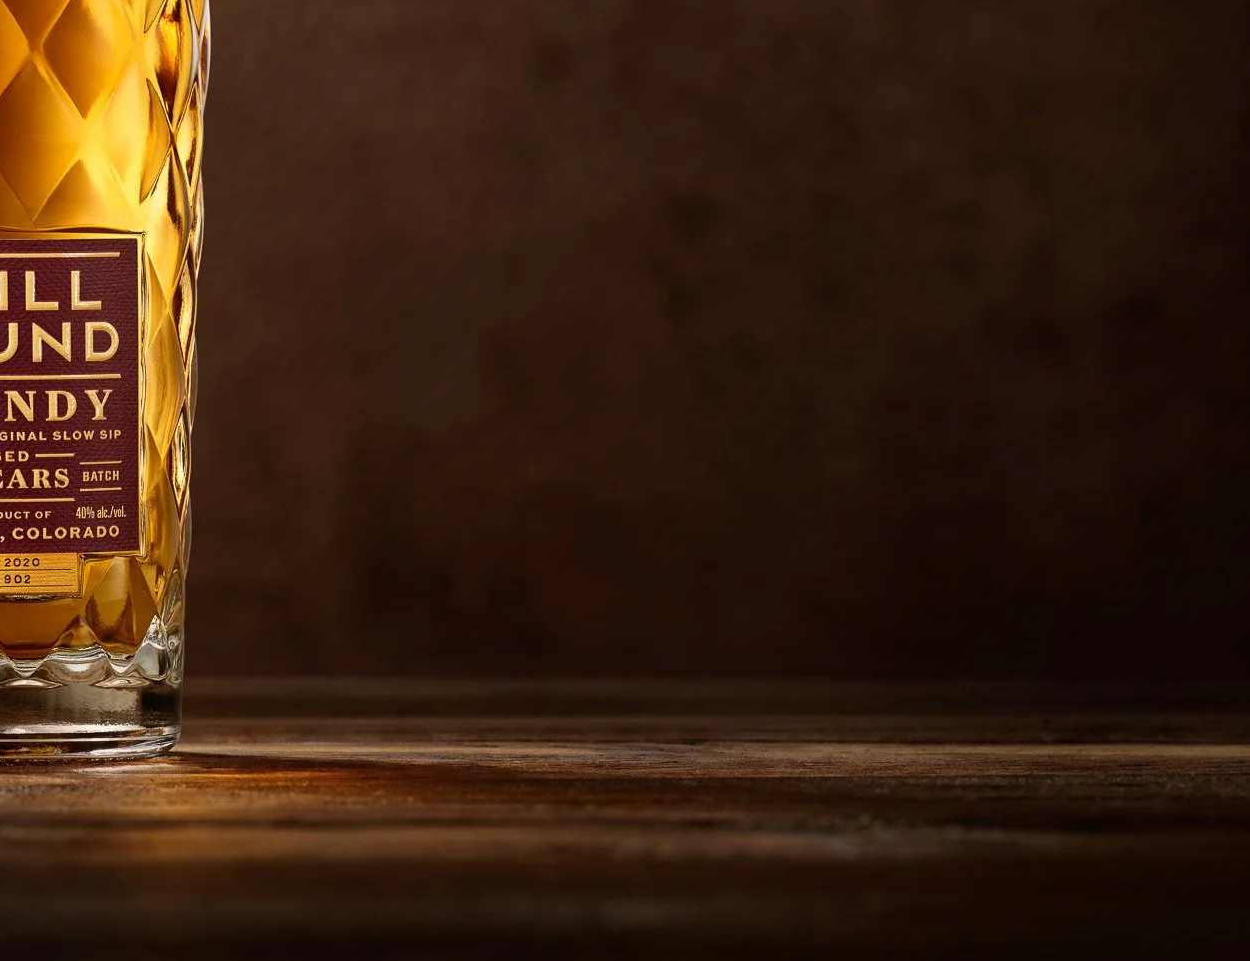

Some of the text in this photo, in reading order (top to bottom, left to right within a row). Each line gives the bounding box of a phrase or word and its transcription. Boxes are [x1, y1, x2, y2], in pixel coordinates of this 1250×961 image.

[52, 430, 94, 441] SLOW
[99, 430, 122, 439] SIP
[82, 470, 120, 482] BATCH
[35, 511, 52, 520] OF
[76, 507, 95, 519] 40%
[12, 526, 120, 540] COLORADO
[4, 558, 40, 567] 2020
[4, 574, 31, 584] 902
